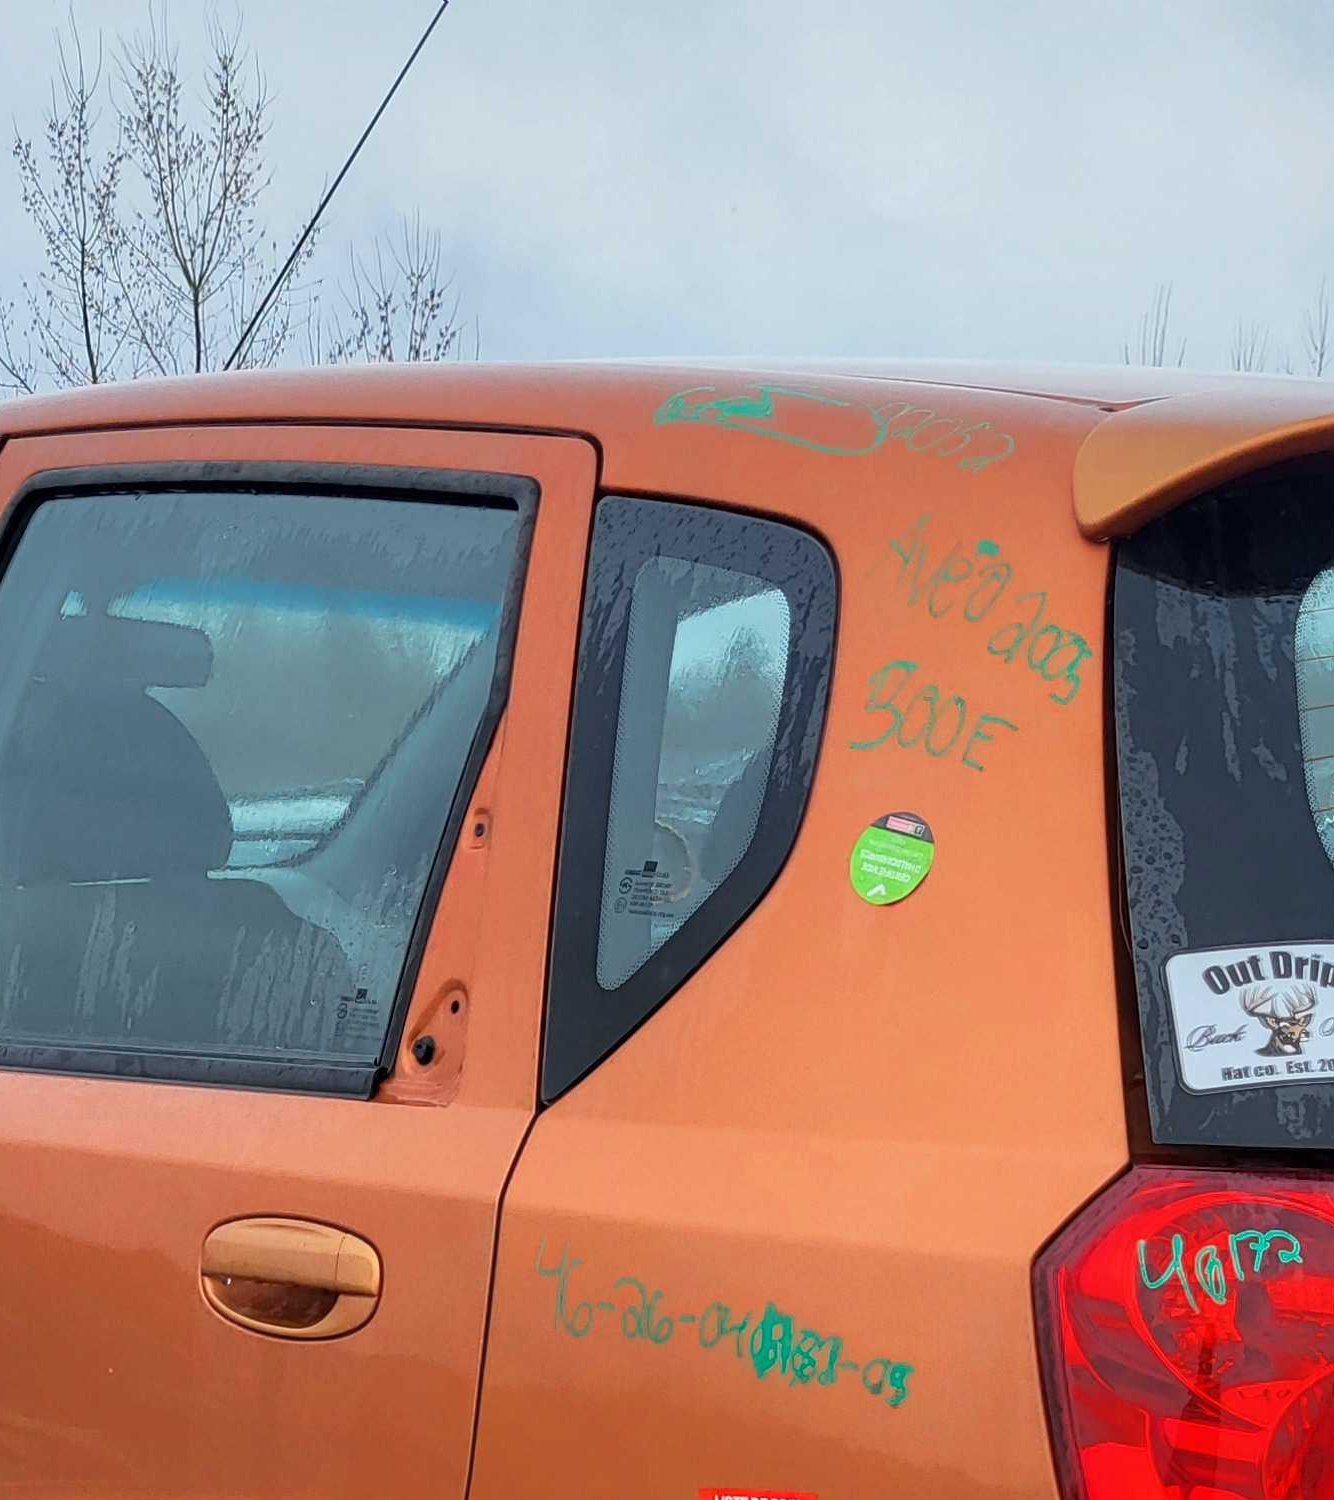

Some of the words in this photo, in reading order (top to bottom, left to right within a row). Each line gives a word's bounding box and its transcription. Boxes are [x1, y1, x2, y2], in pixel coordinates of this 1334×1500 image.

[1202, 954, 1267, 995] Out
[1285, 1059, 1315, 1073] Est.
[1137, 1230, 1303, 1314] 46172
